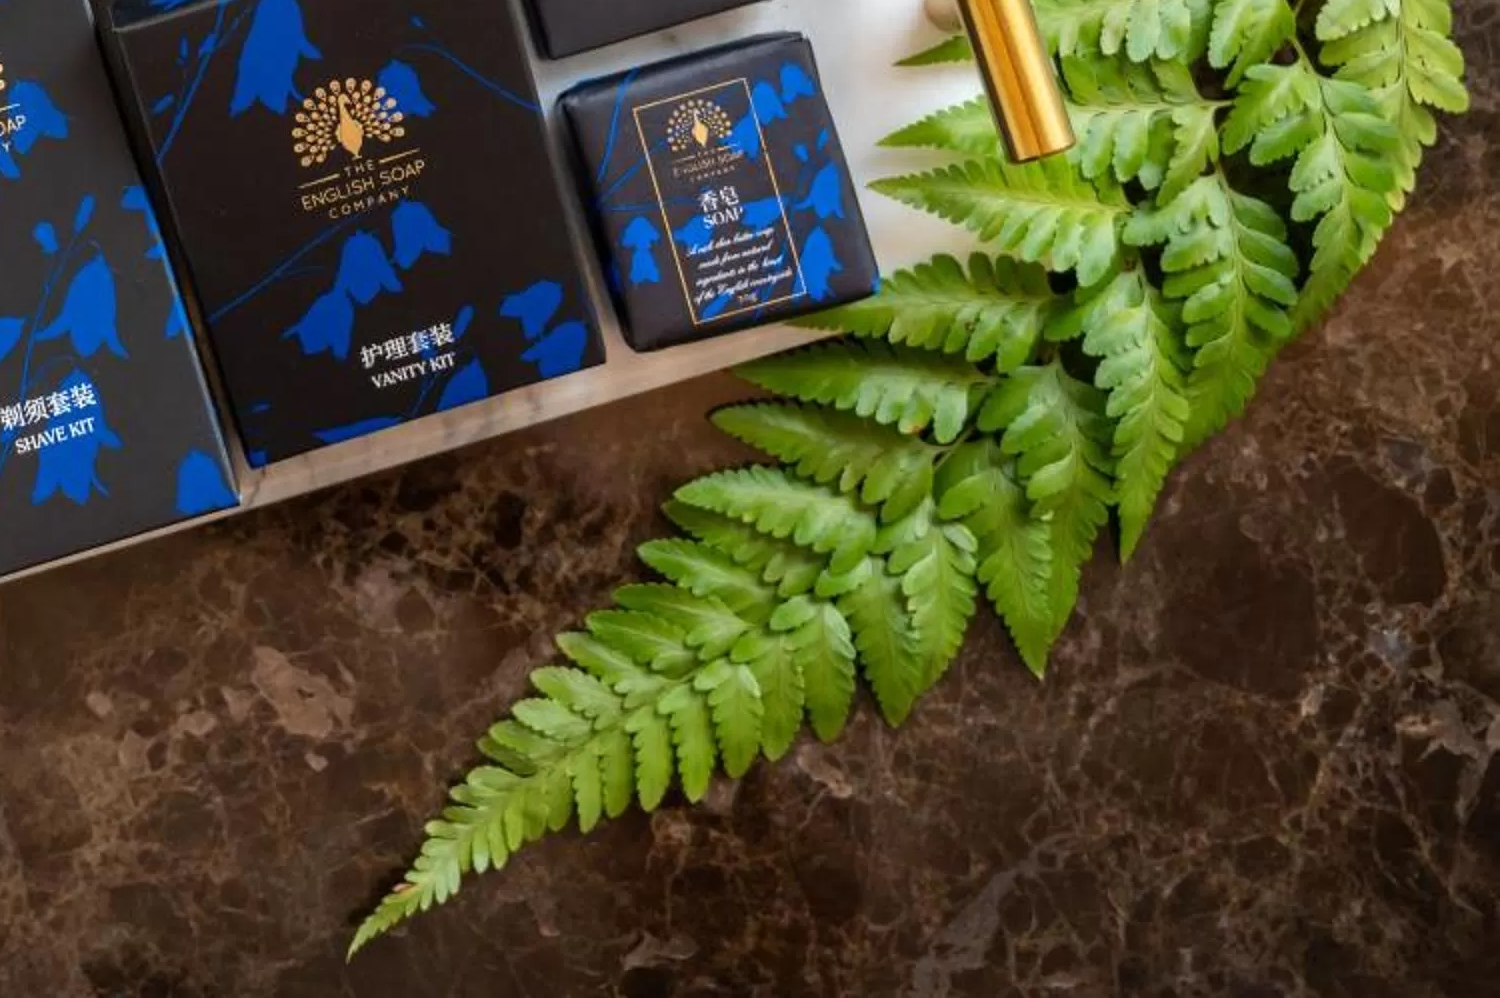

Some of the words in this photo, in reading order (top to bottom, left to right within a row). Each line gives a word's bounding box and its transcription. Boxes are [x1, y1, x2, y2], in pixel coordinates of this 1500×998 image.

[301, 177, 375, 211] ENGLISH
[379, 159, 425, 184] SOAP
[344, 160, 375, 176] THE
[328, 186, 409, 218] COMPANY
[700, 186, 739, 213] 香皂
[703, 206, 743, 229] SOAP
[360, 322, 455, 369] 护理套装
[371, 361, 427, 389] VANITY
[429, 351, 456, 372] KIT
[0, 383, 96, 431] 剃须套装
[15, 425, 68, 454] SHAVE
[68, 417, 95, 438] KIT
